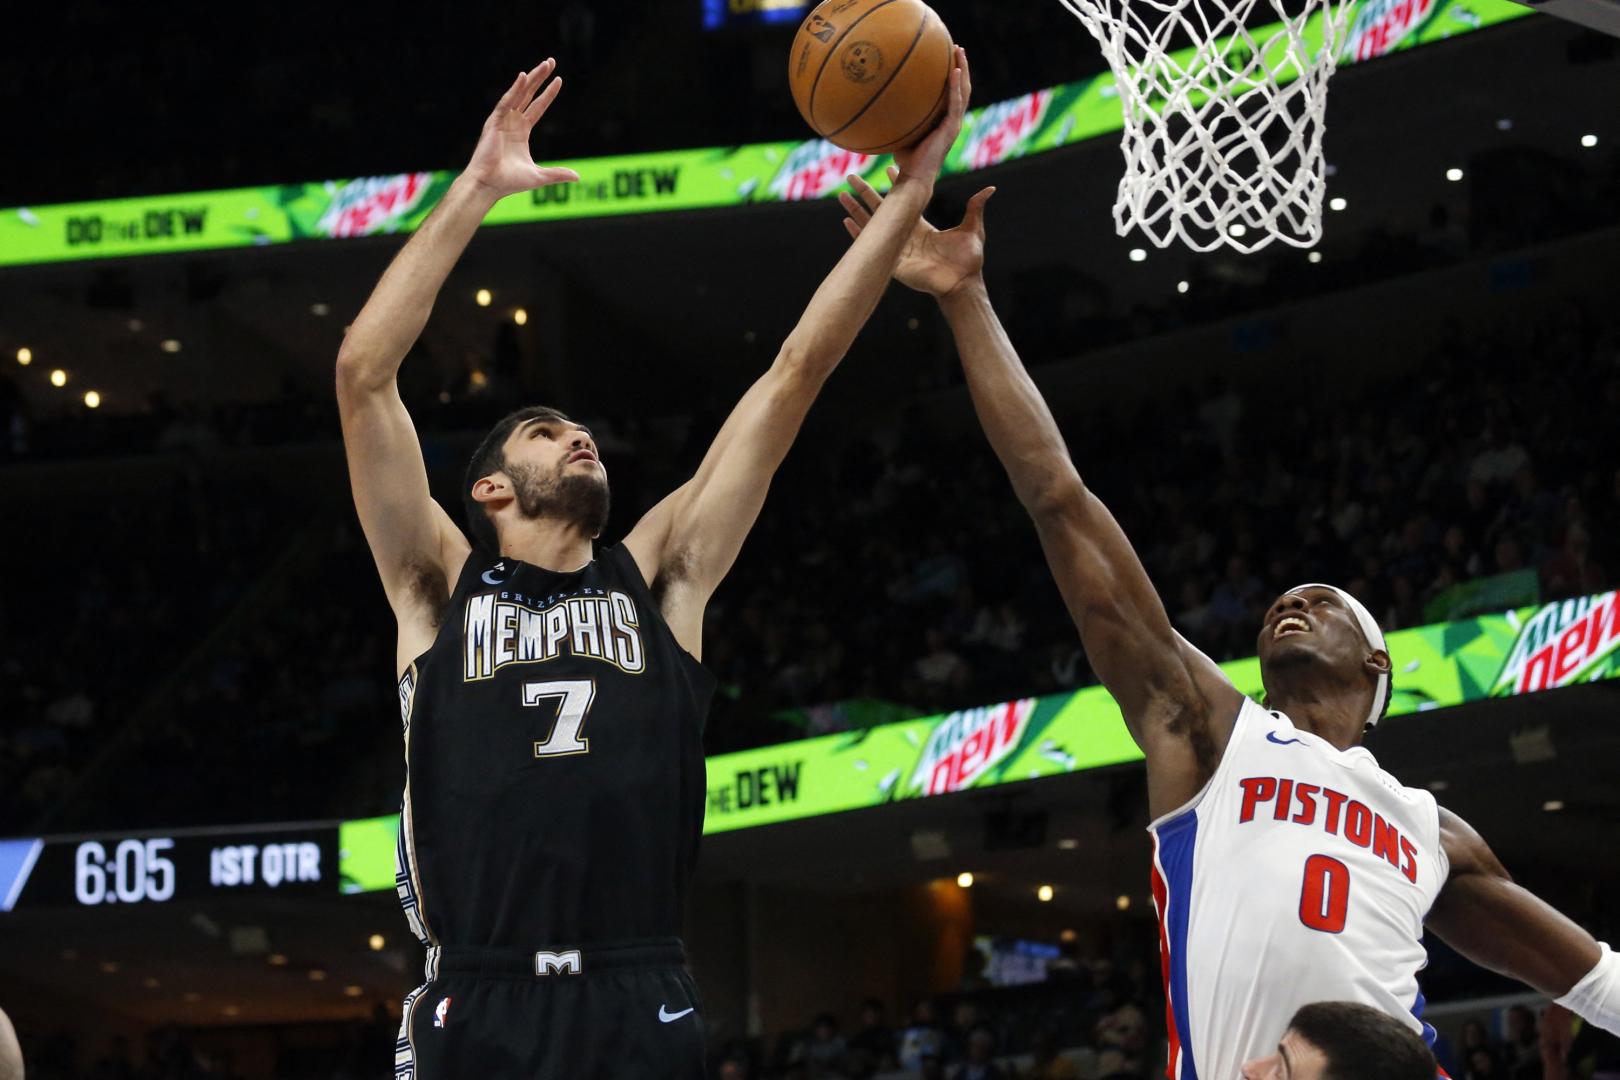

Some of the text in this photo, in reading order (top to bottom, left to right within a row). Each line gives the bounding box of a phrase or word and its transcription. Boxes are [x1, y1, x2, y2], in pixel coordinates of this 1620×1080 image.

[613, 164, 682, 199] DEW
[66, 216, 102, 246] DO
[144, 205, 208, 239] DEW
[464, 591, 645, 682] MEMPHIS
[521, 679, 597, 758] 7
[736, 761, 803, 809] DEW
[1239, 776, 1417, 884] PISTONS
[76, 838, 175, 905] 6:05
[262, 842, 321, 886] QTR
[1298, 853, 1350, 934] 0
